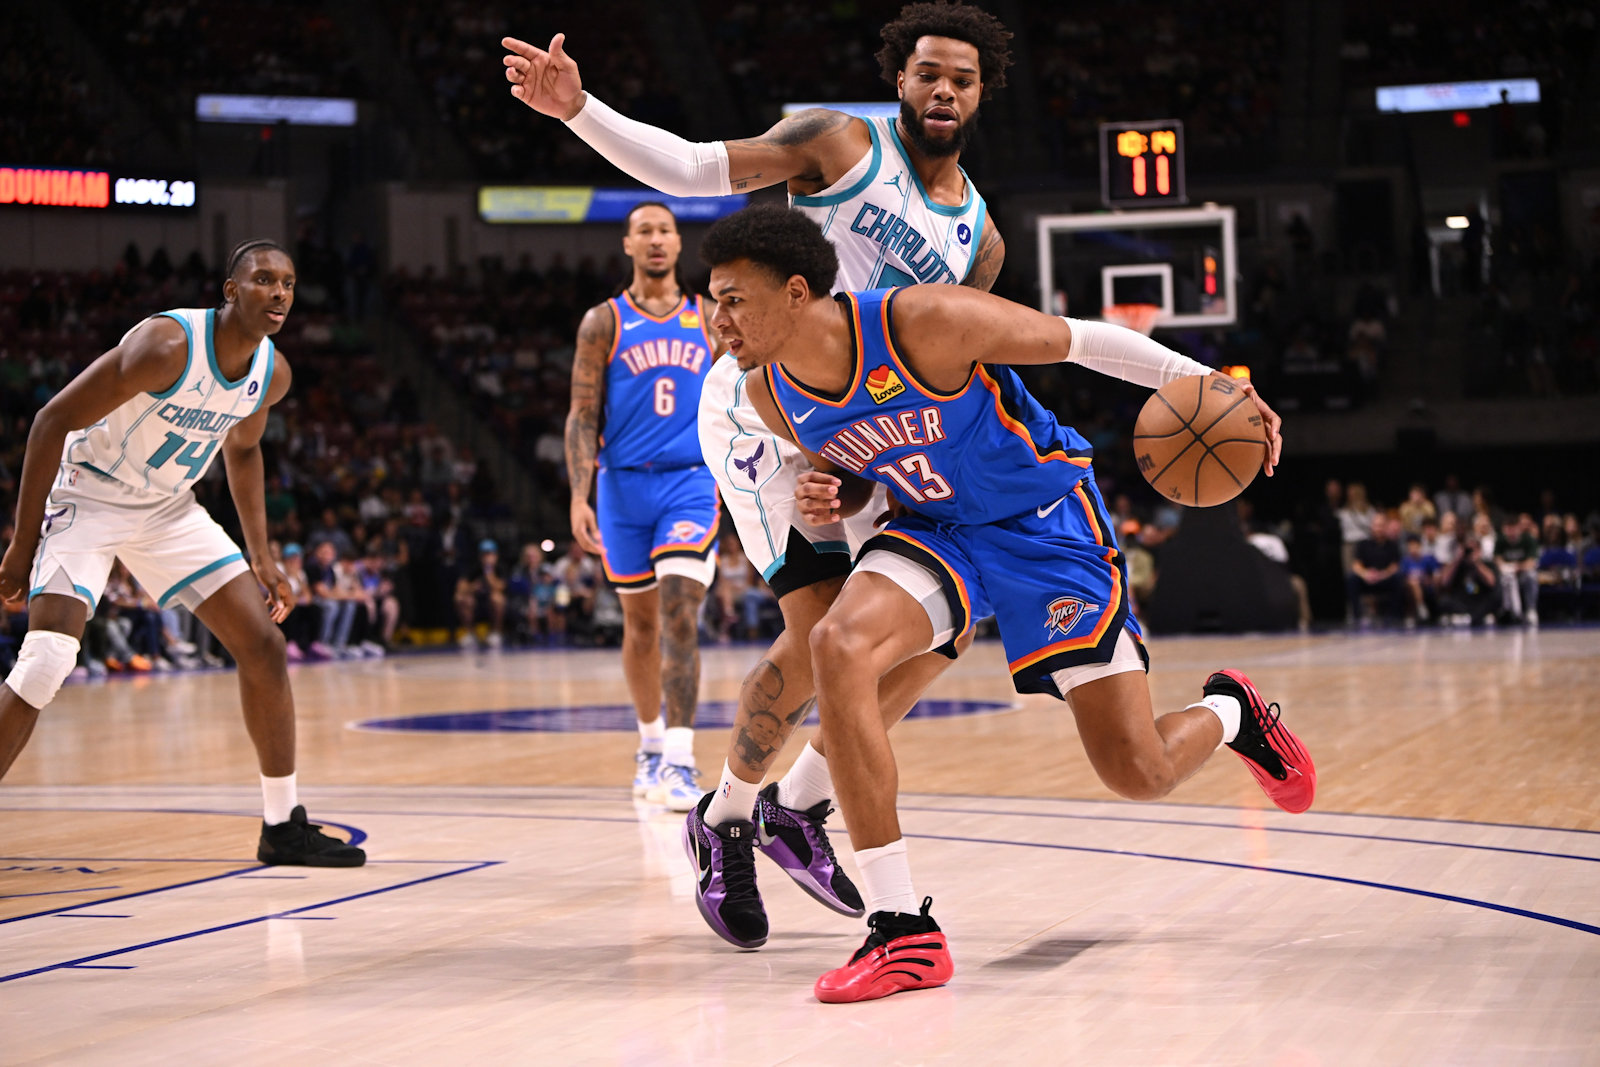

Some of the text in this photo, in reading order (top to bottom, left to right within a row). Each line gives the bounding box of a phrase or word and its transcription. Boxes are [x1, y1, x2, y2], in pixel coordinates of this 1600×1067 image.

[0, 167, 109, 208] DUNHAM
[1132, 154, 1170, 196] 11
[618, 337, 707, 377] THUNDER
[654, 376, 676, 417] 6
[146, 430, 220, 480] 14
[873, 452, 956, 504] 13
